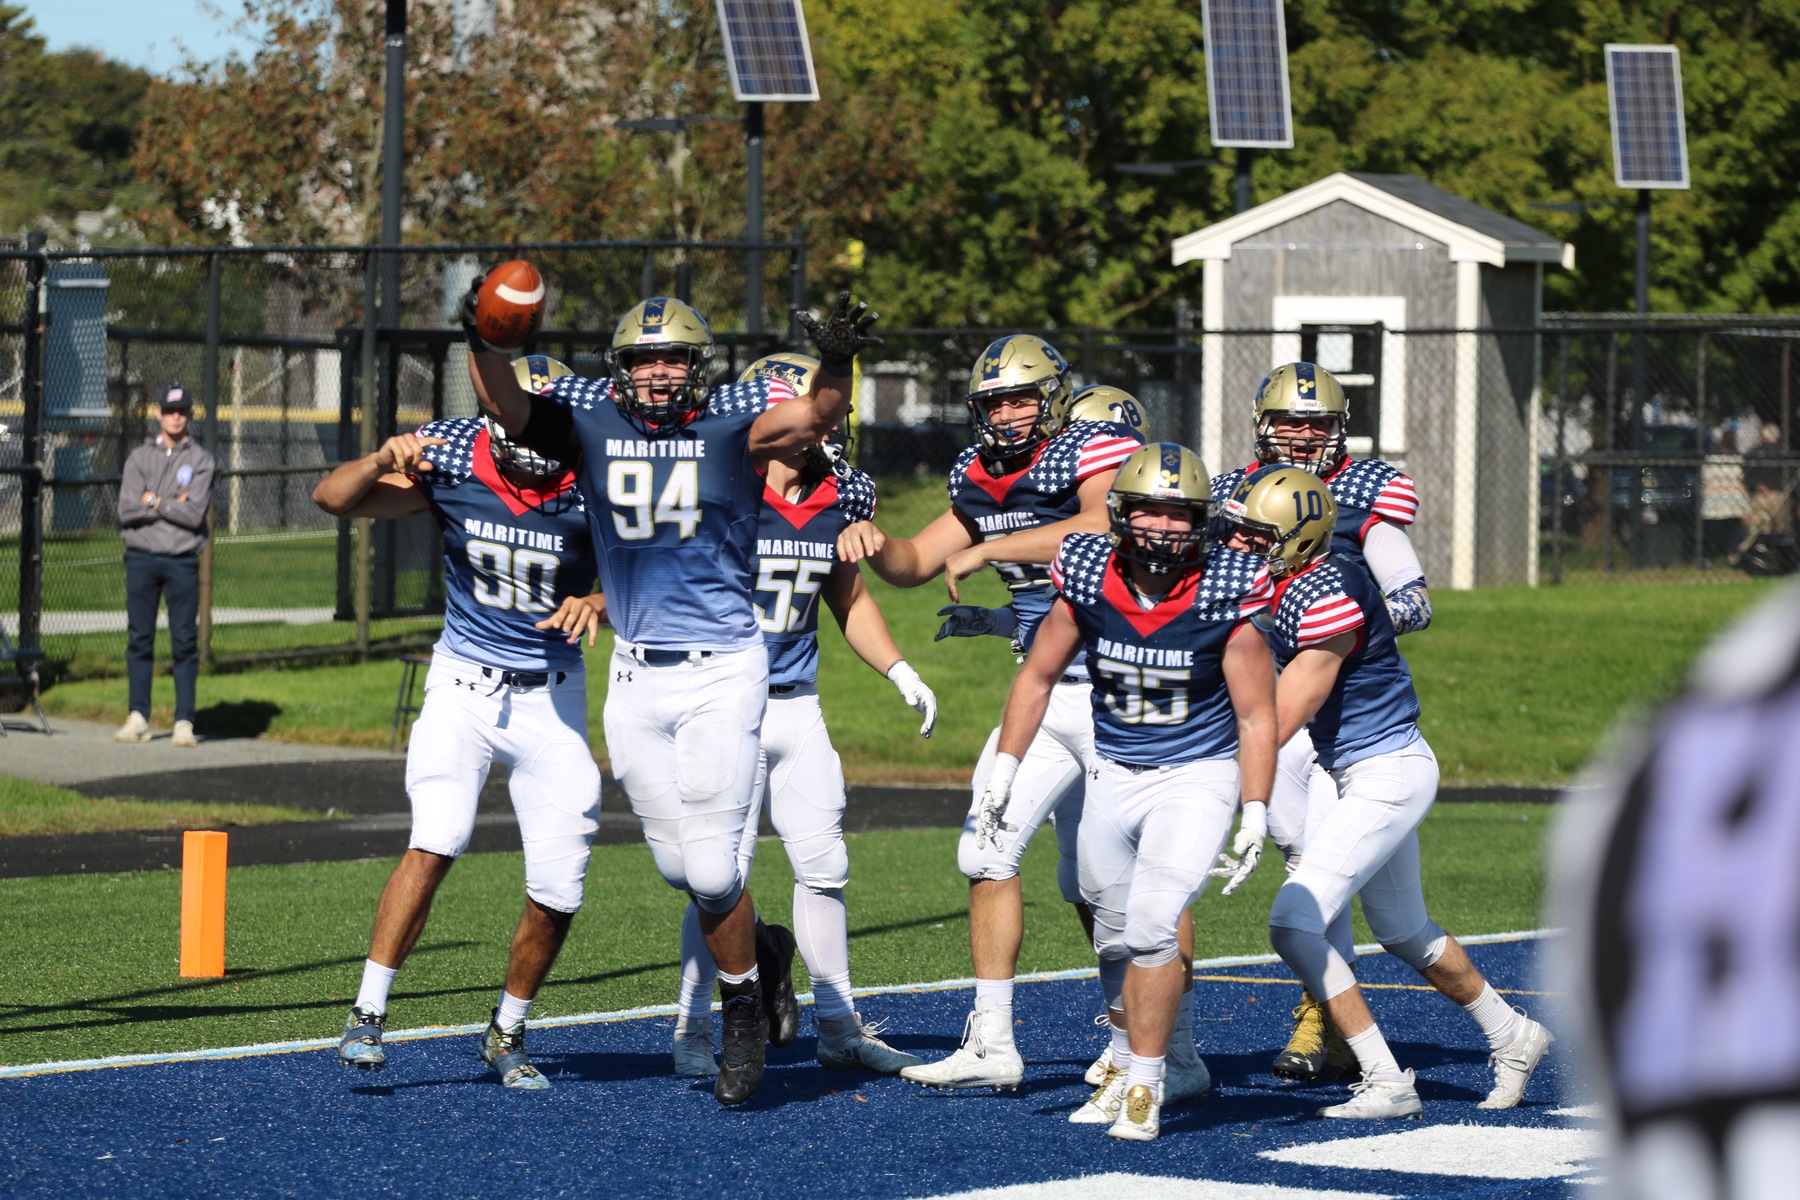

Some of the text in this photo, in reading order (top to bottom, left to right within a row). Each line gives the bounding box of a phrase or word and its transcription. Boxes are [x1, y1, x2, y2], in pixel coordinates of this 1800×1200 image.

[605, 438, 706, 458] MARITIME
[607, 459, 704, 541] 94
[1292, 489, 1323, 521] 10
[465, 518, 564, 552] MARITIME
[974, 511, 1041, 532] MARITIME
[756, 539, 834, 559] MARITIME
[466, 539, 561, 613] 90
[752, 557, 832, 633] 55
[1096, 636, 1195, 667] MARITIME
[1097, 658, 1191, 725] 35
